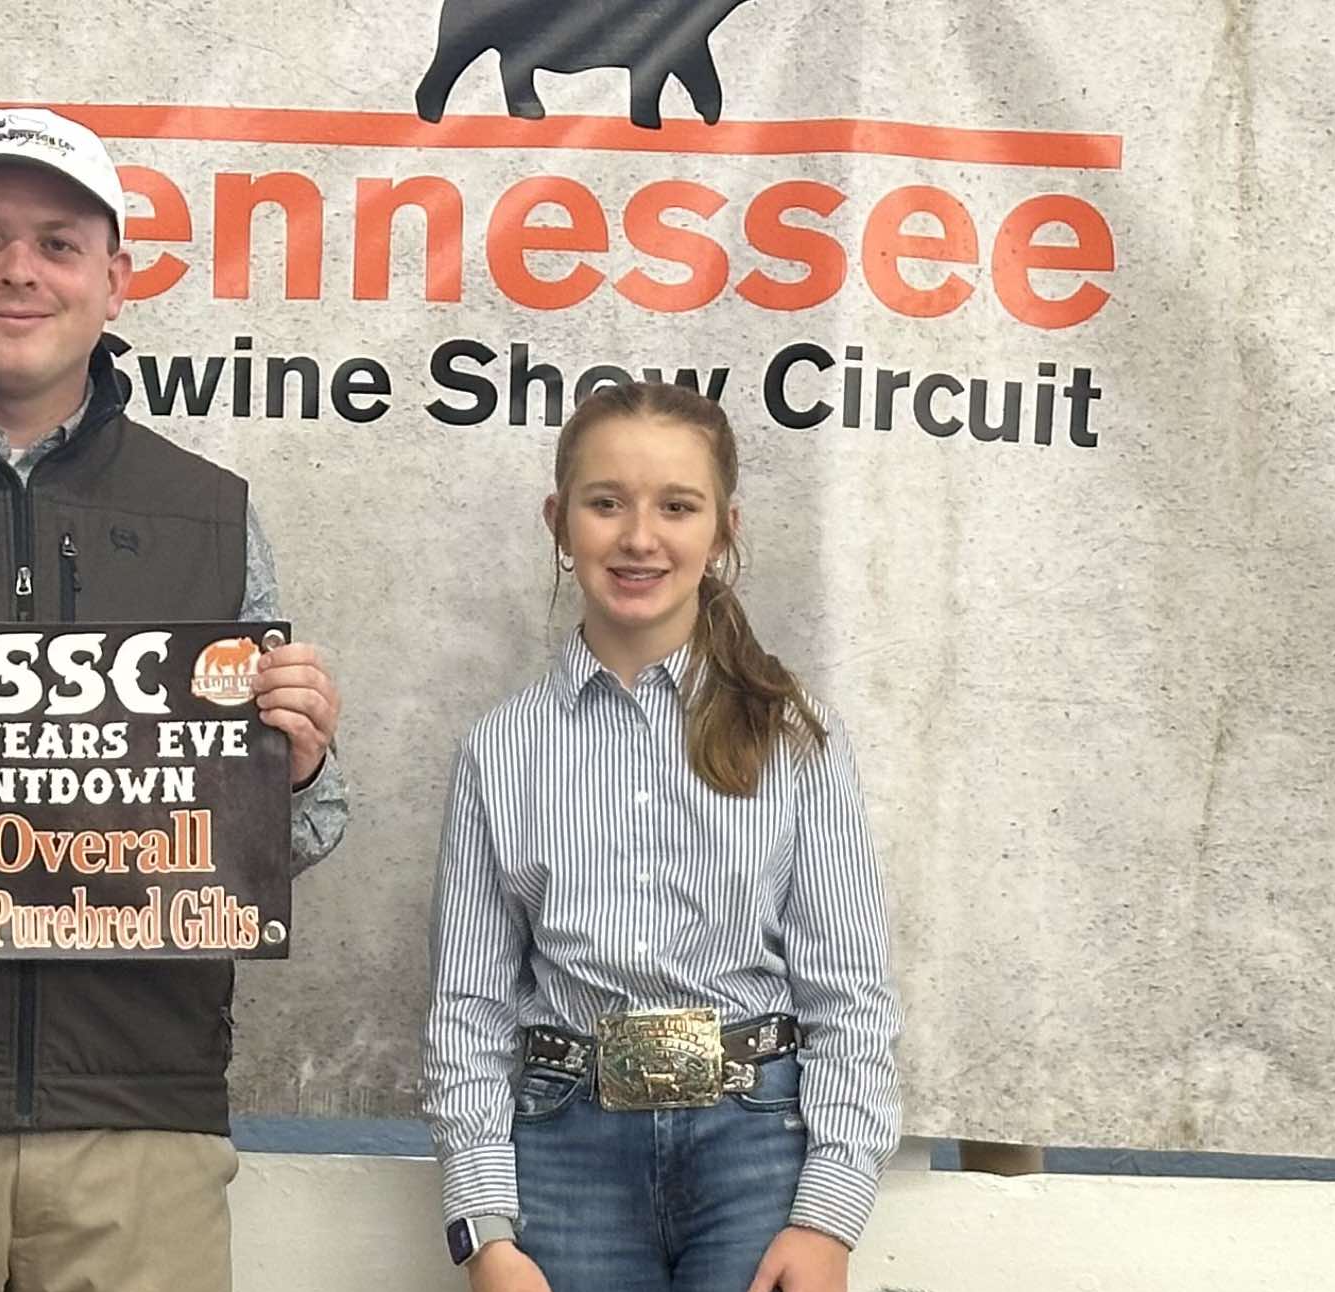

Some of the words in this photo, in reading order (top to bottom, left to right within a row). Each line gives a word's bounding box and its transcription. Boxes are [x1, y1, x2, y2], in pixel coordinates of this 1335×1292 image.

[115, 164, 1115, 330] ennessee
[763, 341, 1102, 448] Circuit
[156, 719, 250, 758] EVE
[169, 886, 259, 950] Gilts
